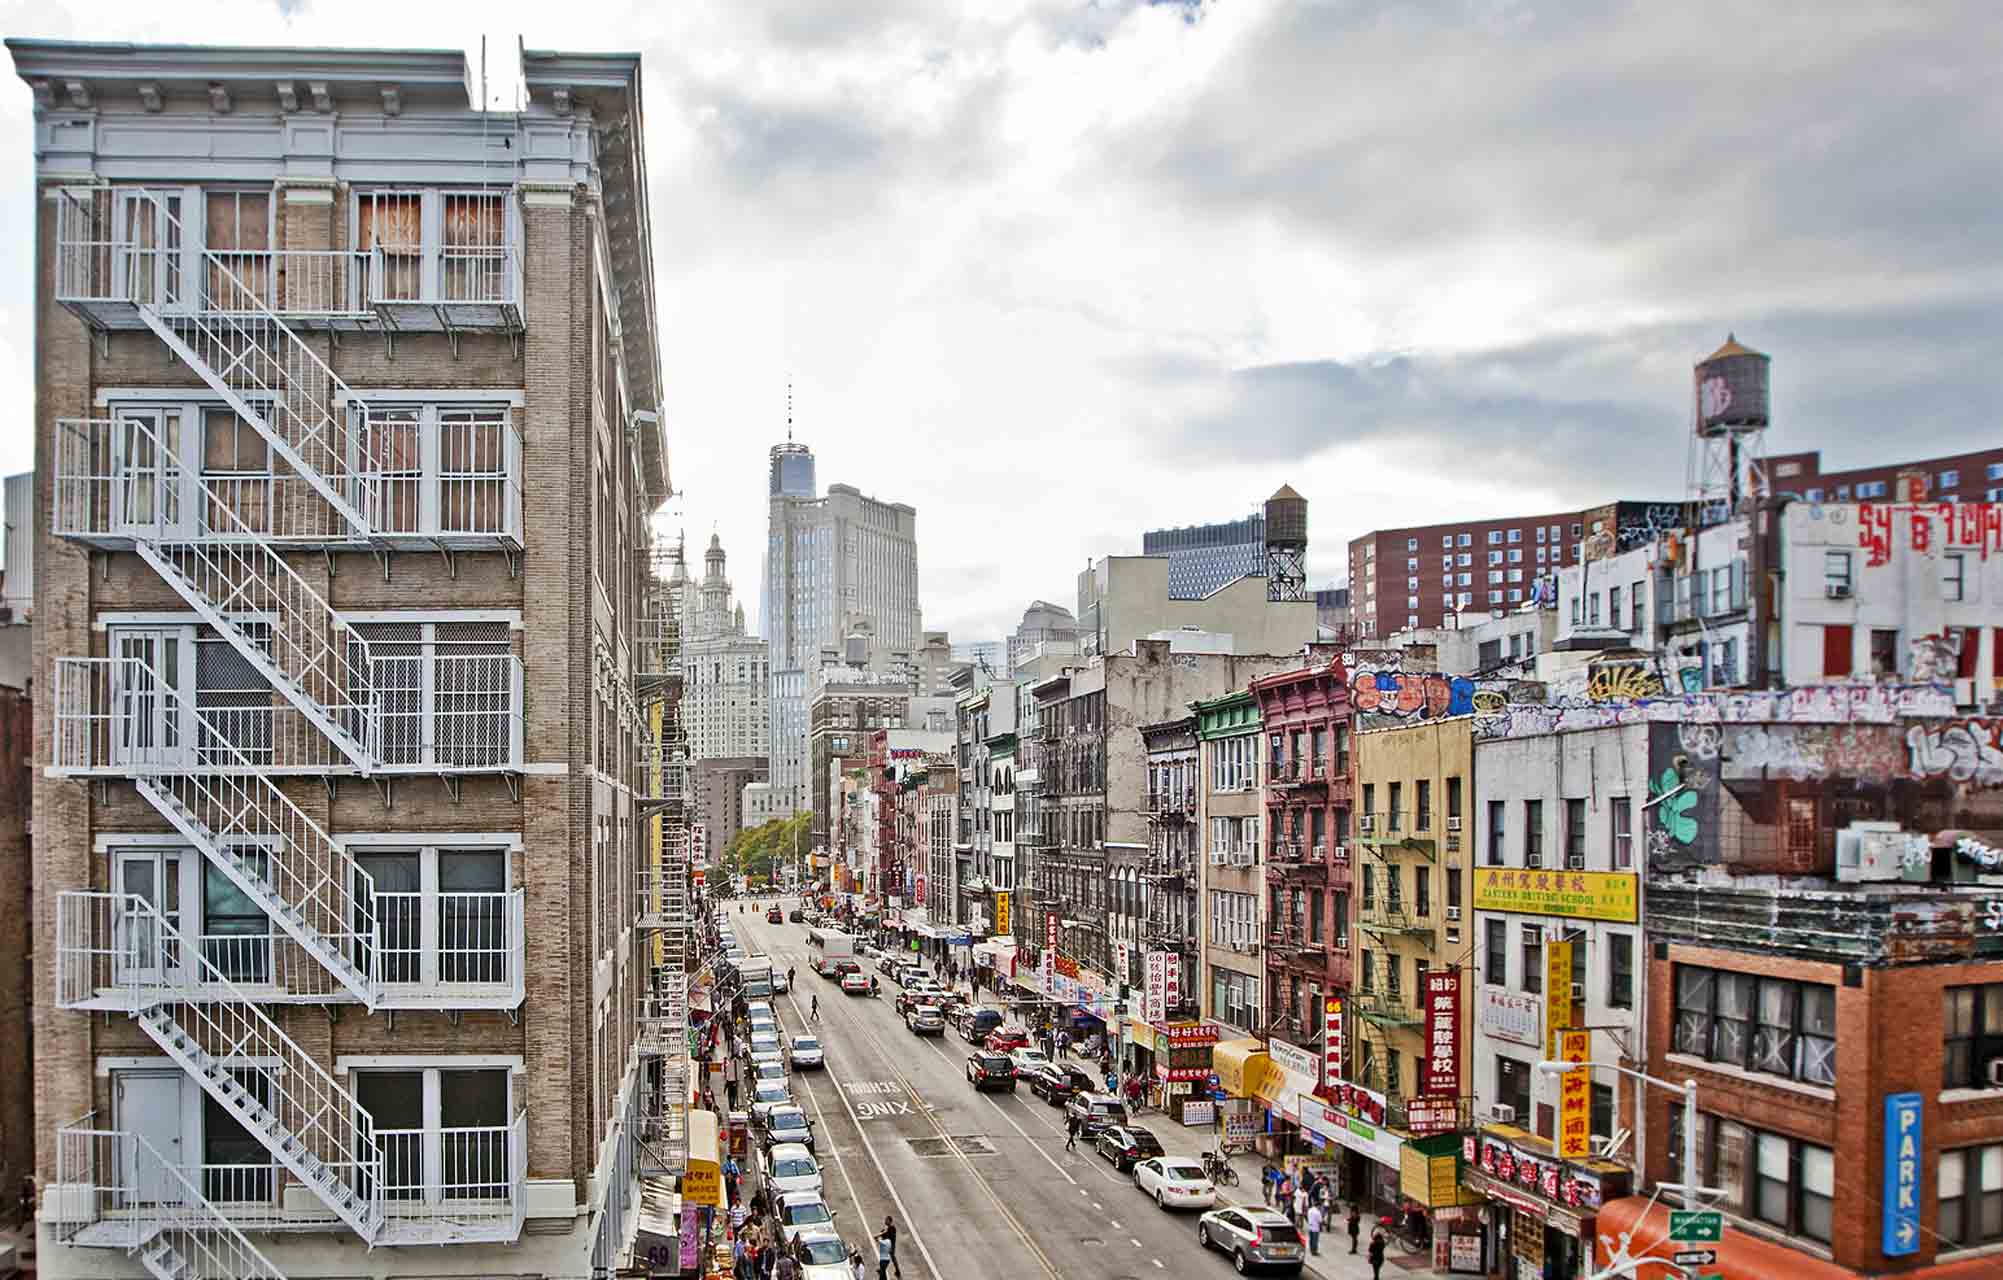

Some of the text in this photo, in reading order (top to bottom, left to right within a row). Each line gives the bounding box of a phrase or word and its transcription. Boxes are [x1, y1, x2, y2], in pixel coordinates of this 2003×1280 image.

[1560, 893, 1595, 905] SCHOOL
[1326, 1001, 1341, 1013] 66
[856, 1101, 917, 1118] XING
[1898, 1108, 1917, 1209] PARK
